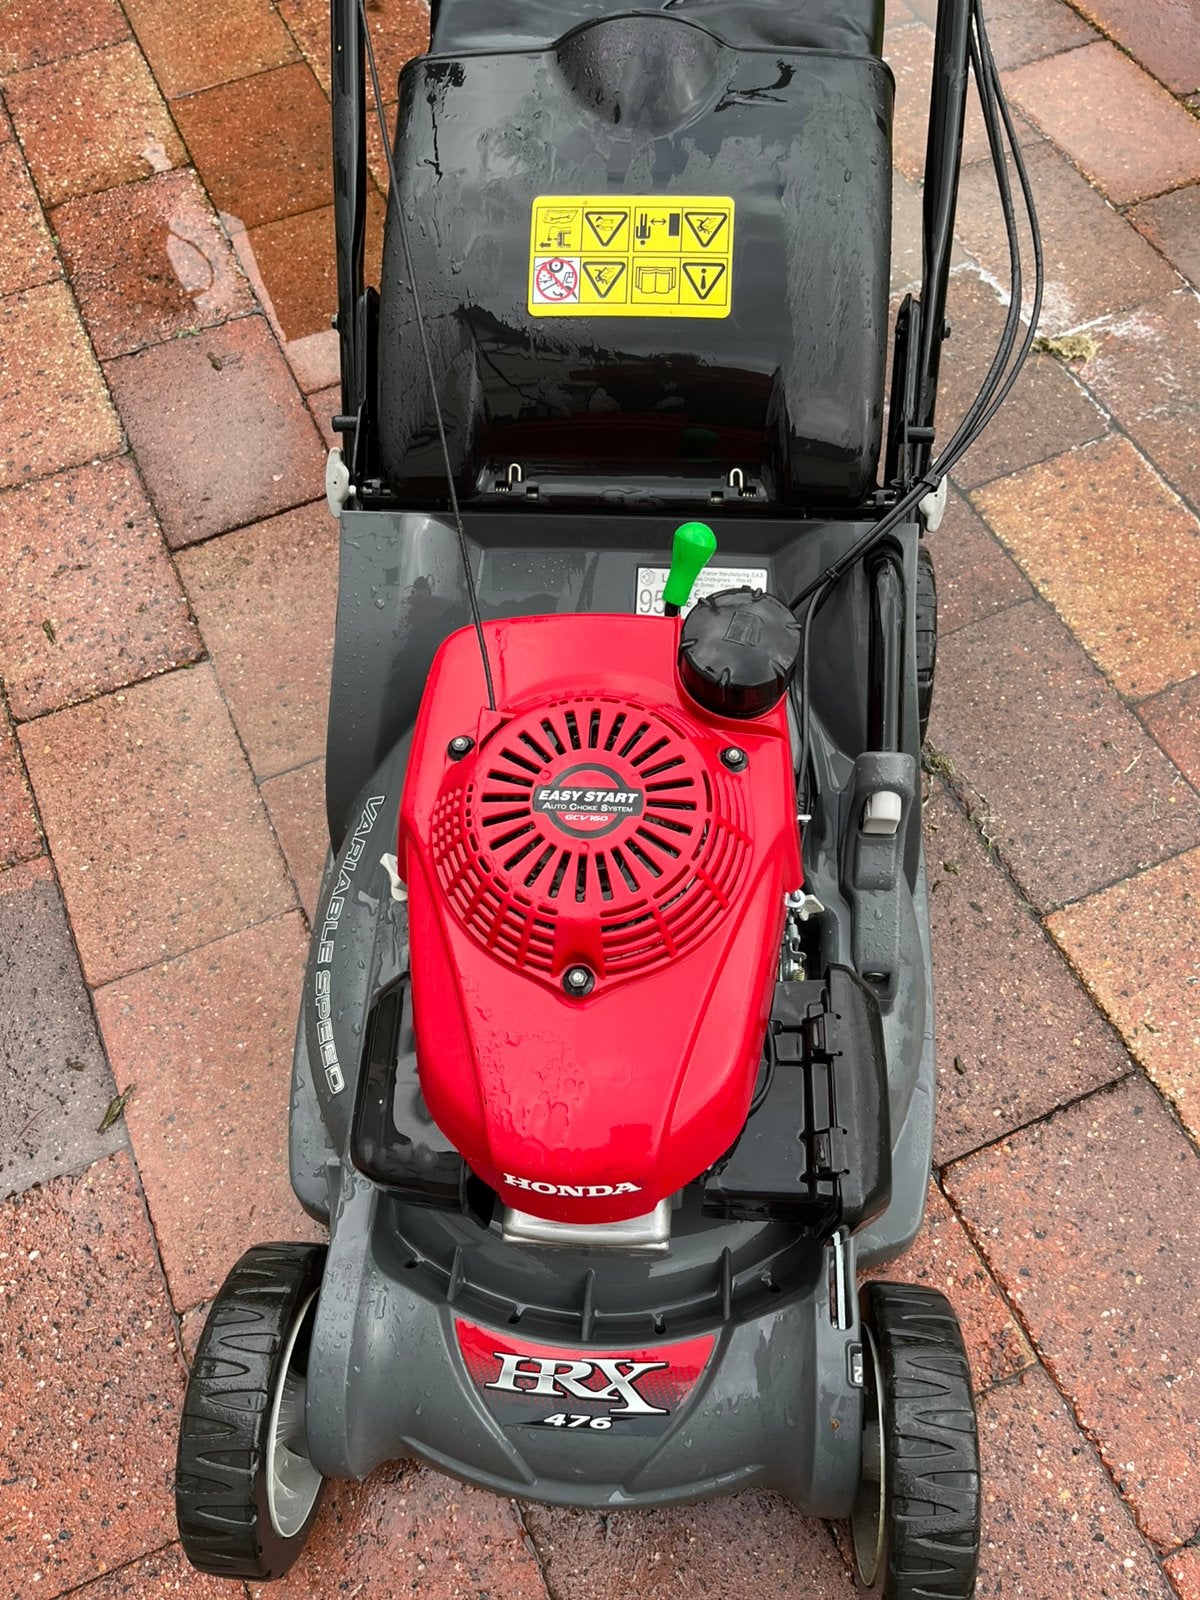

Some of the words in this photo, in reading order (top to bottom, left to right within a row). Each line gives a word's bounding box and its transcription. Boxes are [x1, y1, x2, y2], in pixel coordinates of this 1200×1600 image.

[538, 789, 584, 801] EASY
[584, 791, 639, 804] START
[565, 814, 608, 822] GCV160
[317, 795, 386, 964] VARIABLE
[315, 970, 347, 1095] SPEED
[503, 1172, 642, 1198] HONDA
[484, 1351, 671, 1416] HRX
[543, 1412, 614, 1430] 476
